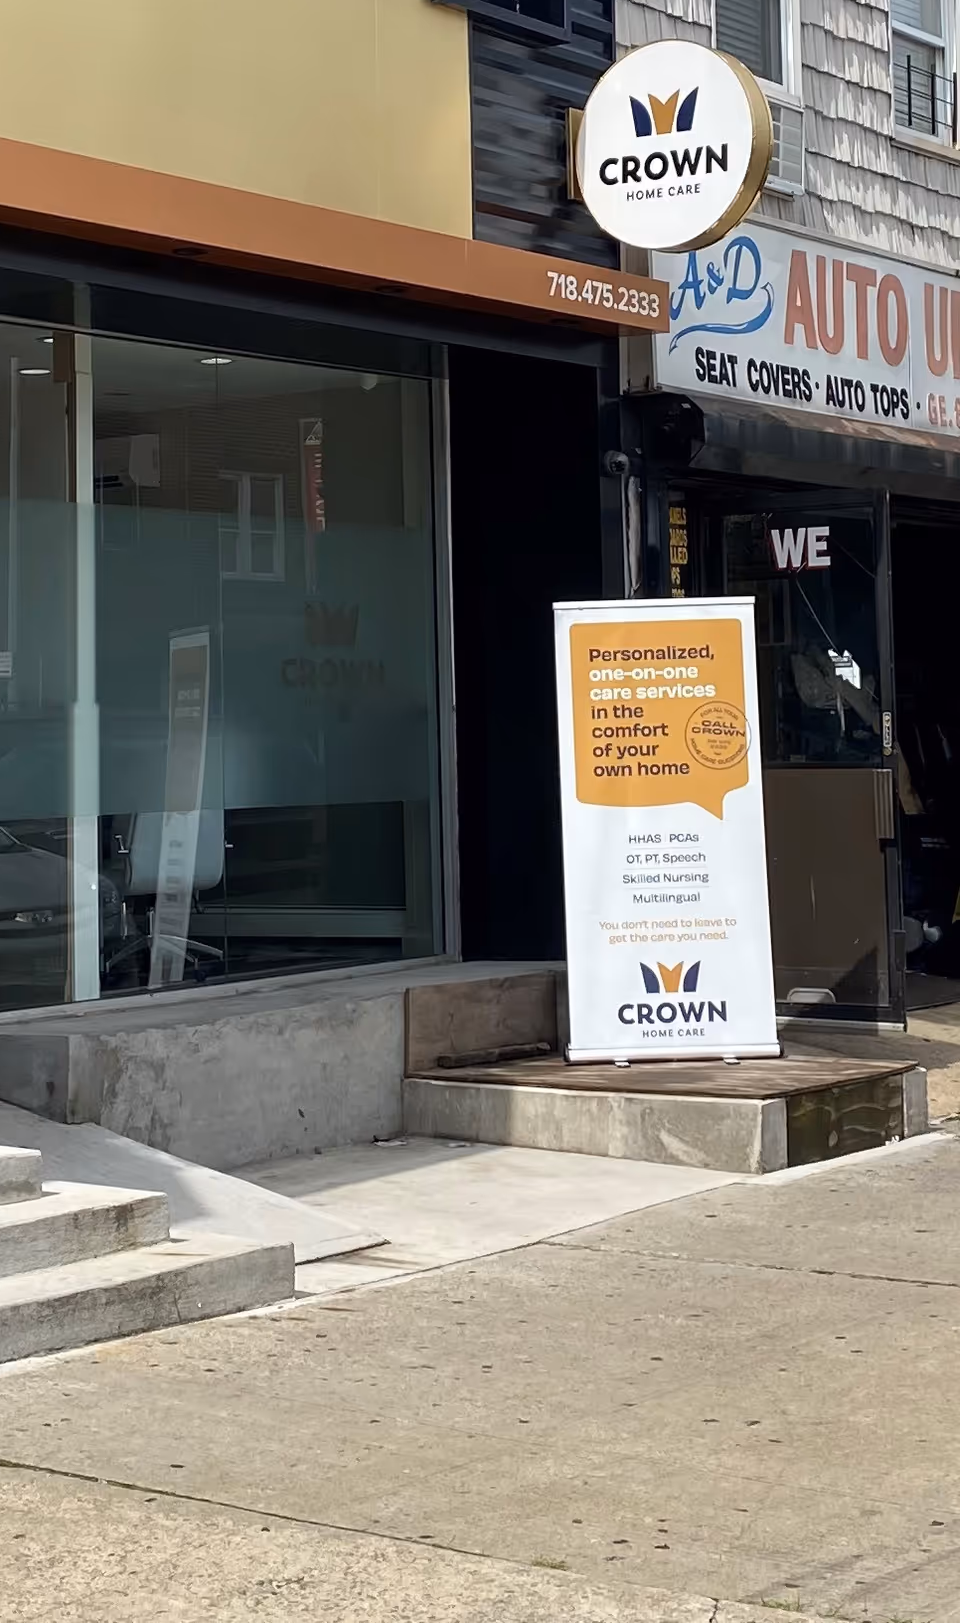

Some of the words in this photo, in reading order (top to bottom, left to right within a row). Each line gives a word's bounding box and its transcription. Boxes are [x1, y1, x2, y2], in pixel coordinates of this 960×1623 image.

[598, 143, 729, 186] CROWN
[626, 186, 663, 202] HOME
[667, 183, 701, 198] CARE
[546, 271, 660, 318] 718.475.2333
[783, 248, 909, 368] AUTO
[695, 346, 739, 389] SEAT
[747, 357, 814, 403] COVERS
[825, 374, 866, 413] AUTO
[870, 383, 910, 420] TOPS
[771, 526, 831, 569] WE
[589, 644, 715, 662] Personalized,
[589, 665, 698, 682] one-on-one
[590, 687, 632, 701] care
[636, 684, 716, 700] services
[591, 706, 608, 720] in
[612, 705, 644, 719] the
[592, 722, 669, 739] comfort
[691, 727, 746, 737] CROWN
[701, 720, 737, 730] CALL
[592, 743, 613, 758] of
[616, 744, 659, 760] your
[593, 763, 633, 777] own
[637, 761, 691, 776] home
[626, 854, 643, 865] OT,
[645, 854, 661, 864] PT,
[662, 852, 706, 864] Speech
[622, 873, 661, 884] Skilled
[663, 872, 710, 884] Nursing
[632, 892, 701, 904] Multilingual
[599, 920, 619, 930] You
[651, 919, 678, 929] need
[680, 919, 693, 928] to
[694, 918, 723, 927] leave
[725, 918, 737, 927] to
[609, 934, 627, 945] get
[629, 933, 648, 943] the
[650, 933, 675, 942] care
[677, 932, 697, 943] you
[617, 1000, 728, 1025] CROWN
[642, 1029, 674, 1038] HOME
[678, 1028, 705, 1037] CARE
